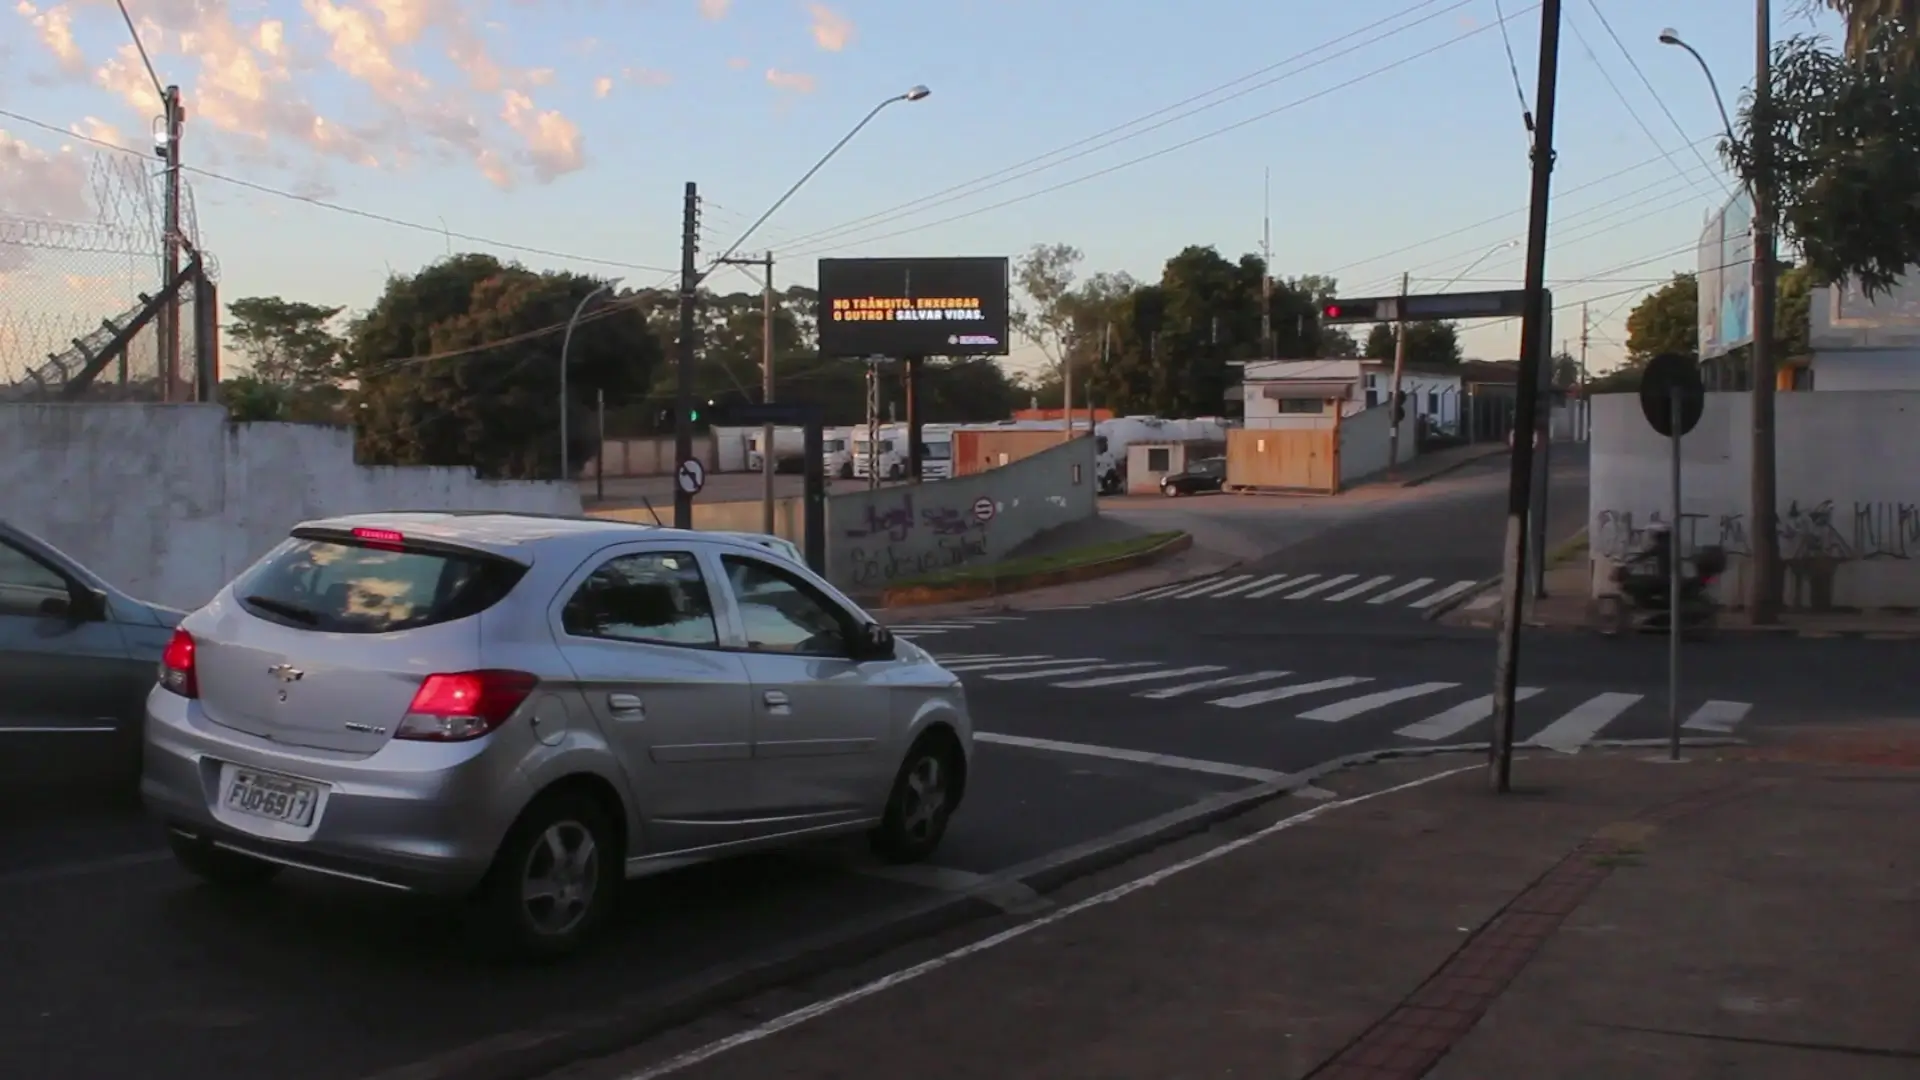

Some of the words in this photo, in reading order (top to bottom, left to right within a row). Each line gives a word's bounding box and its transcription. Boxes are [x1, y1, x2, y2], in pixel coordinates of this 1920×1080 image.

[833, 299, 850, 309] NO
[917, 298, 979, 309] ENXERGAR
[833, 310, 842, 321] O
[844, 310, 884, 321] OUTRO
[886, 309, 894, 321] É
[896, 310, 942, 321] SALVAR
[944, 310, 985, 321] VIDAS.
